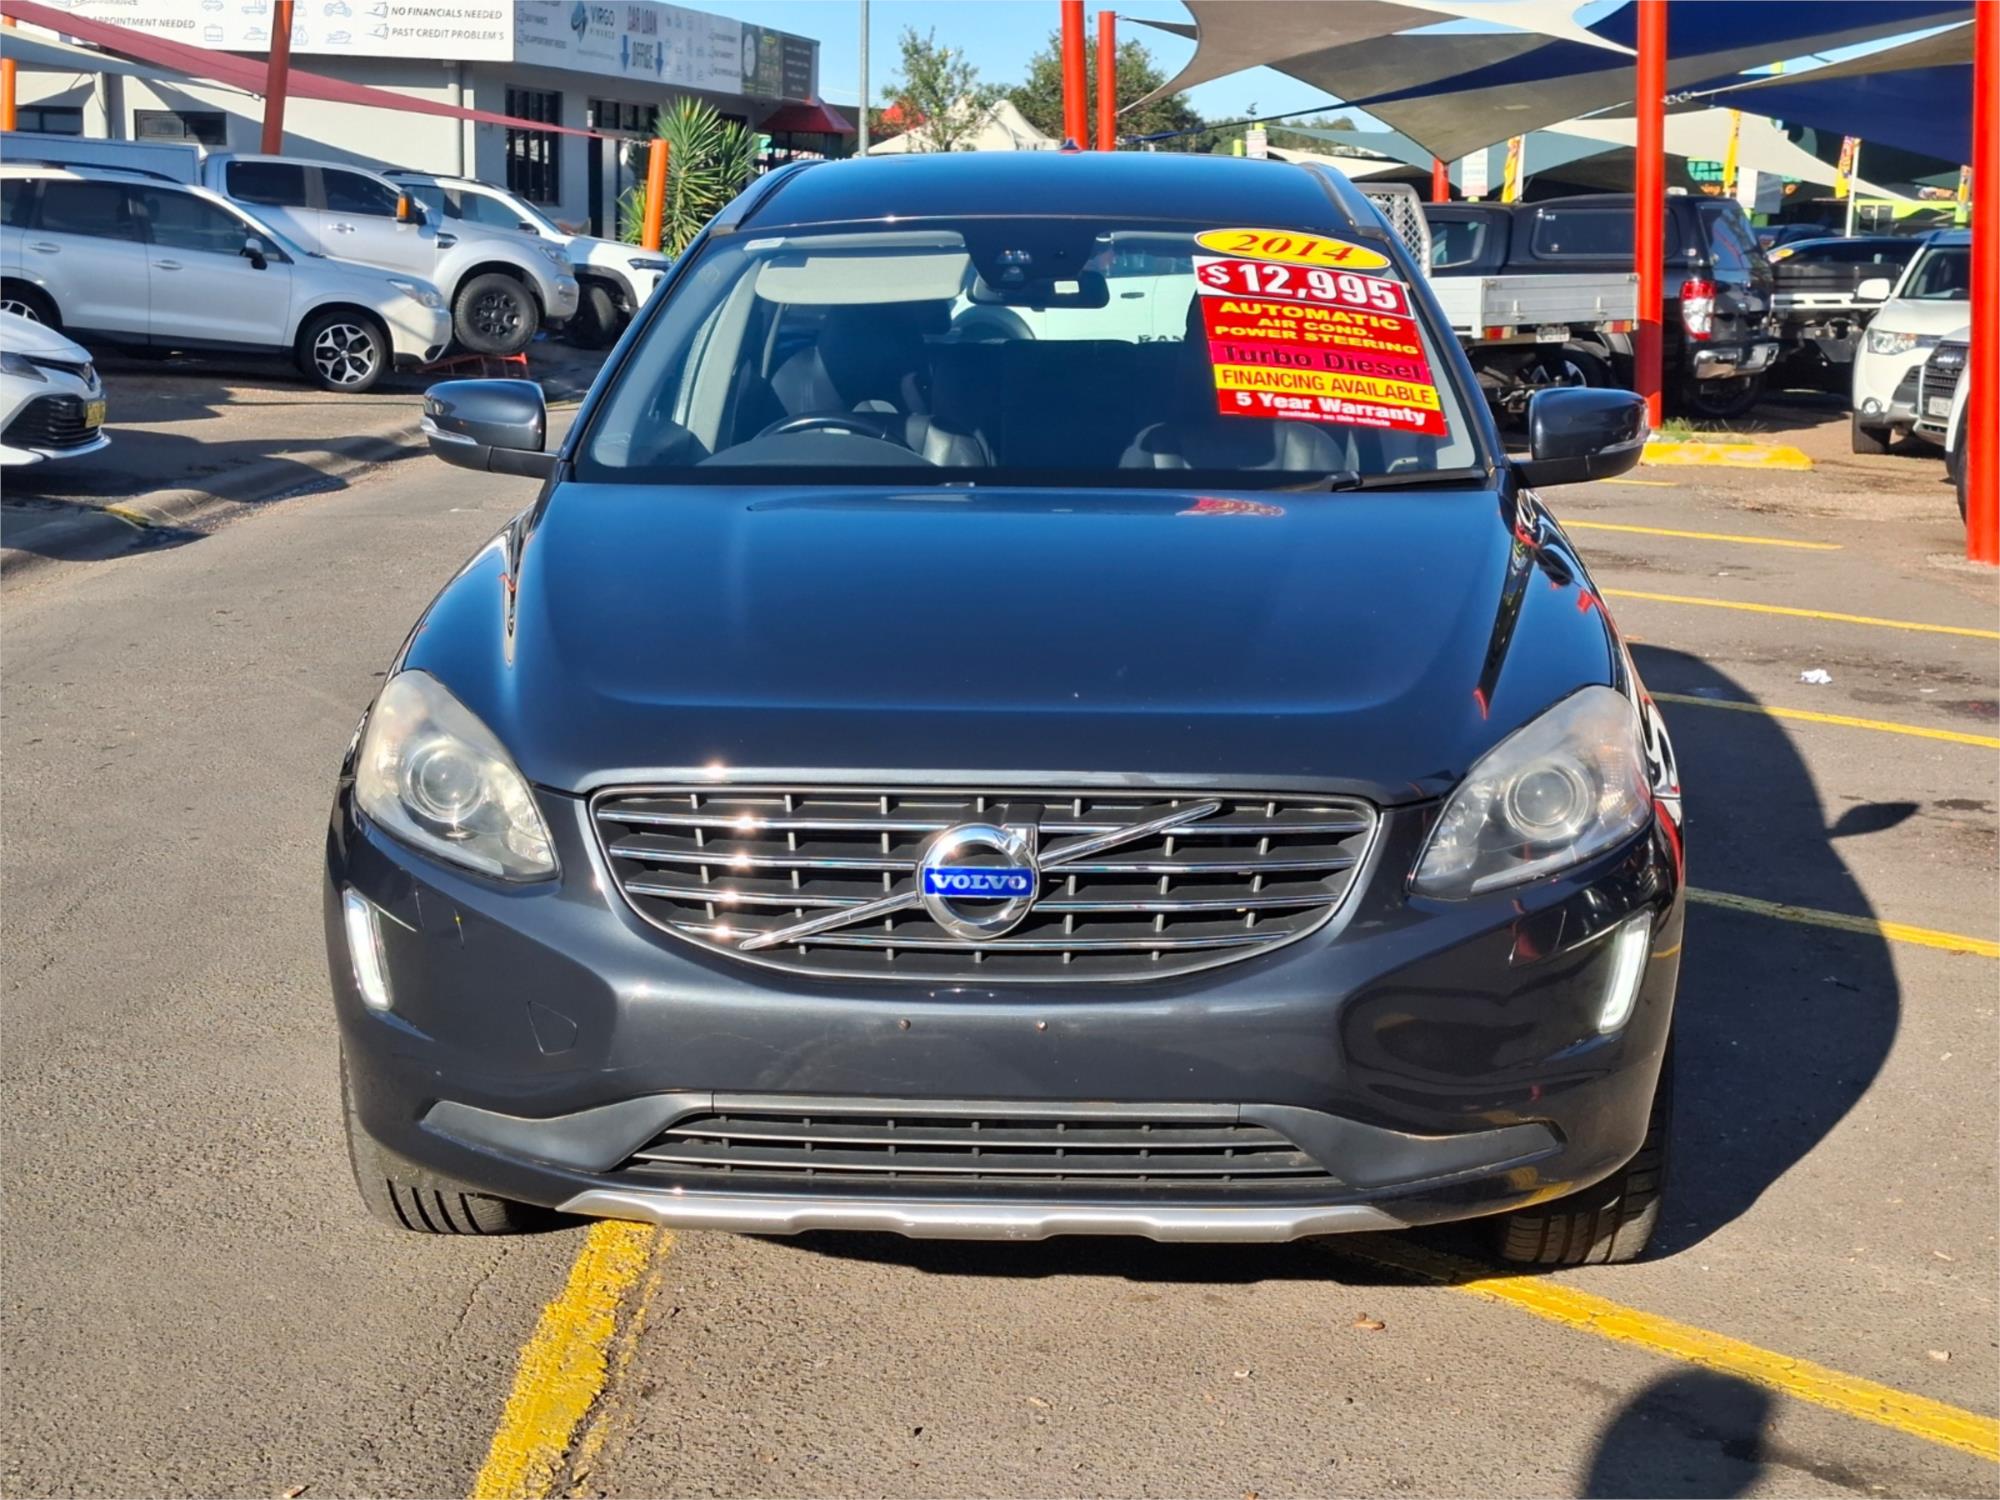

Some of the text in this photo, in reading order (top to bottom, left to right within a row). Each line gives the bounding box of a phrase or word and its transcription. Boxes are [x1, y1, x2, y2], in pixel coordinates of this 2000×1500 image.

[159, 19, 196, 28] NEEDED
[391, 7, 503, 19] NO FINANCIALS NEEDED
[392, 27, 504, 40] PAST CREDIT PROBLEM'S
[1230, 234, 1354, 261] 2014
[1220, 301, 1402, 330] AUTOMATIC
[1258, 318, 1374, 338] AIR COND.
[1215, 326, 1419, 355] POWER STEERING
[1223, 345, 1421, 380] Turbo Diesel
[1222, 369, 1432, 405] FINANCING AVAILABLE
[1236, 392, 1425, 426] 5 Year Warranty
[929, 873, 1027, 890] VOLVO
